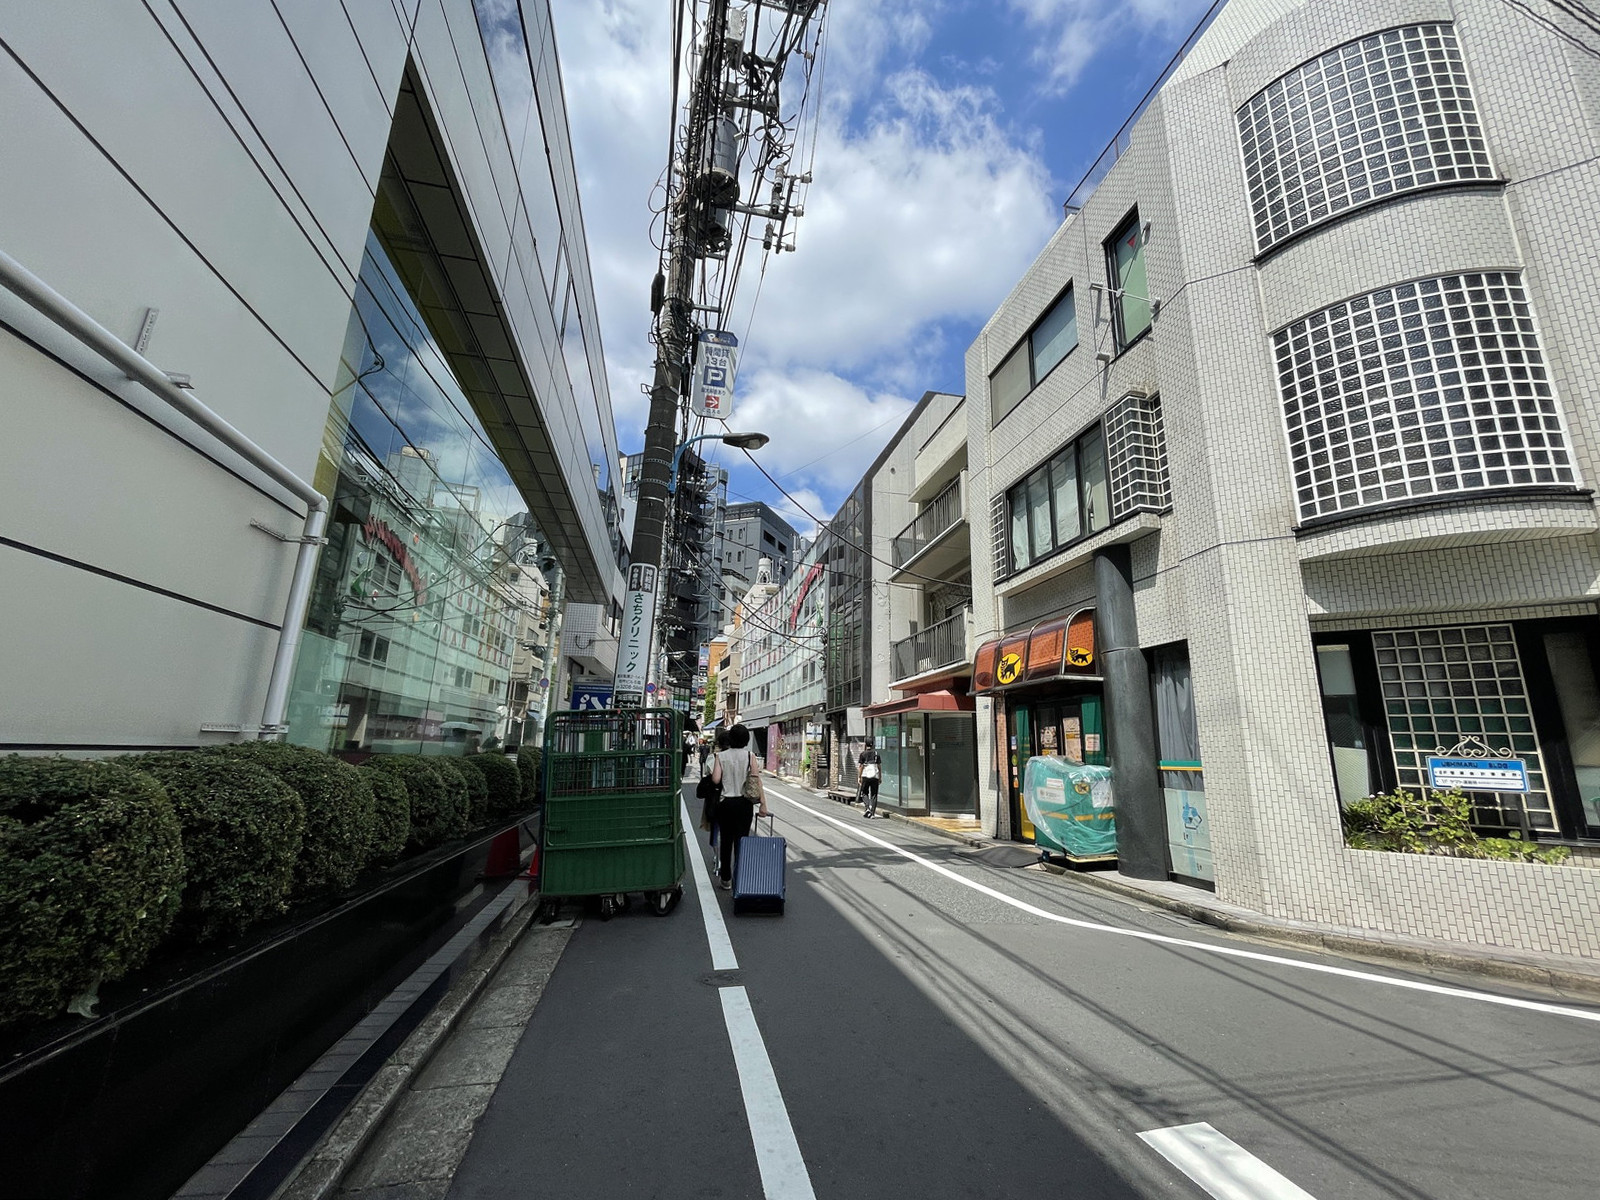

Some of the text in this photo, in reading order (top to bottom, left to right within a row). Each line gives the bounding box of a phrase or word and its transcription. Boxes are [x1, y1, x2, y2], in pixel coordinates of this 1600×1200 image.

[706, 356, 727, 367] 13台
[707, 369, 723, 384] P
[626, 592, 644, 673] さちクリニック
